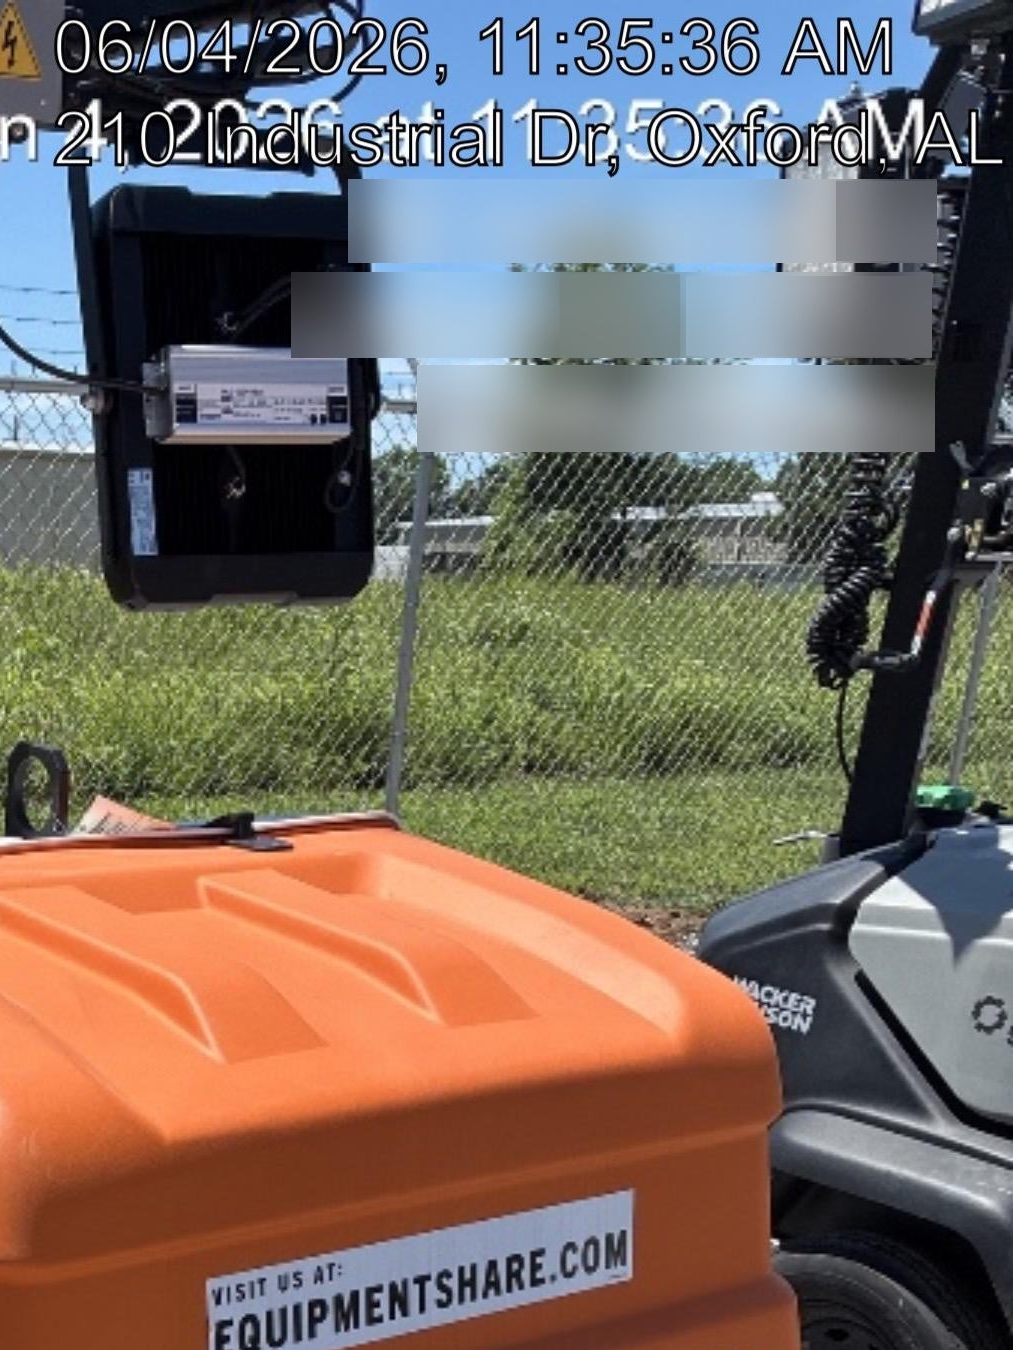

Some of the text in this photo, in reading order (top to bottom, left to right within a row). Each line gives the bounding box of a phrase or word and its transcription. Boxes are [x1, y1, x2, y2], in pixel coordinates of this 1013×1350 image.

[211, 1262, 343, 1306] VISIT US AT:
